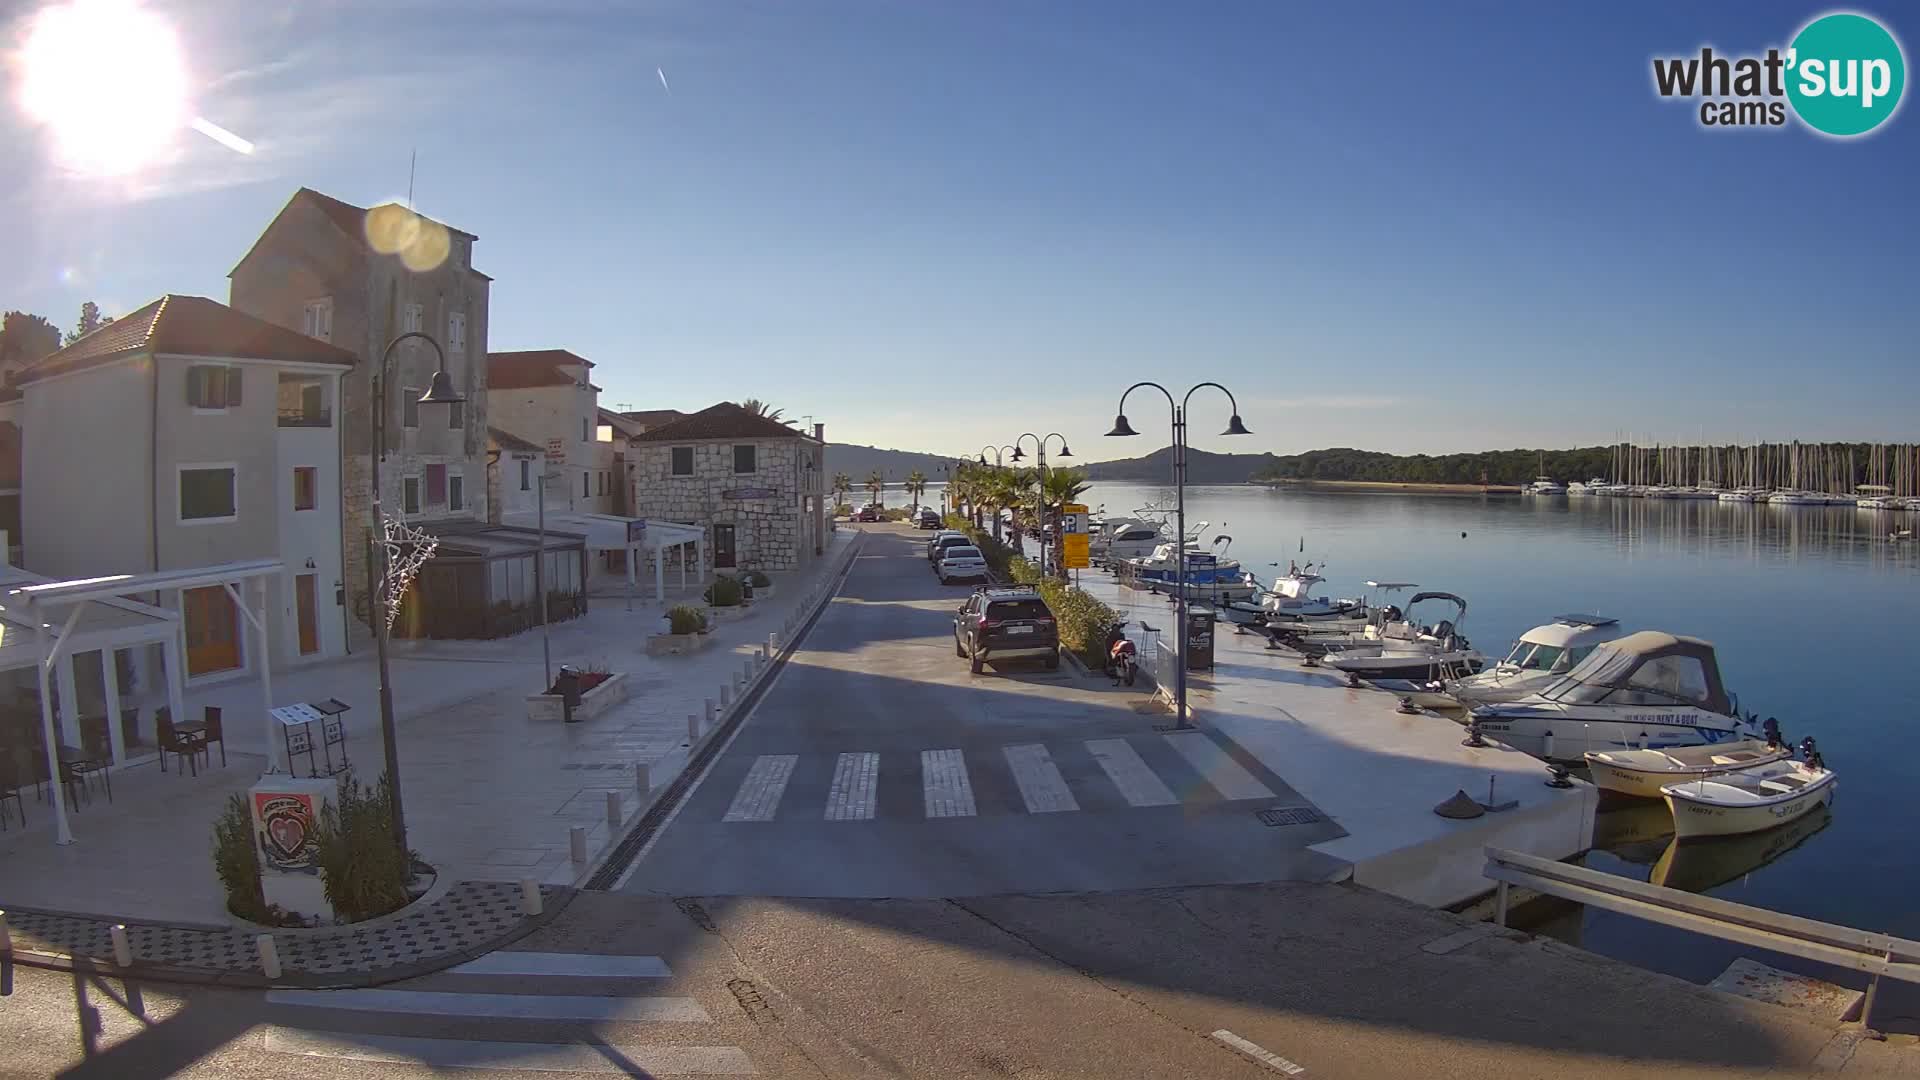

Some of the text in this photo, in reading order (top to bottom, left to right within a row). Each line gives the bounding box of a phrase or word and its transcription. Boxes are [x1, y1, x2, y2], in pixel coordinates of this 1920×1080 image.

[1066, 516, 1076, 533] P
[1656, 714, 1674, 723] RENT
[1681, 715, 1698, 725] BOAT
